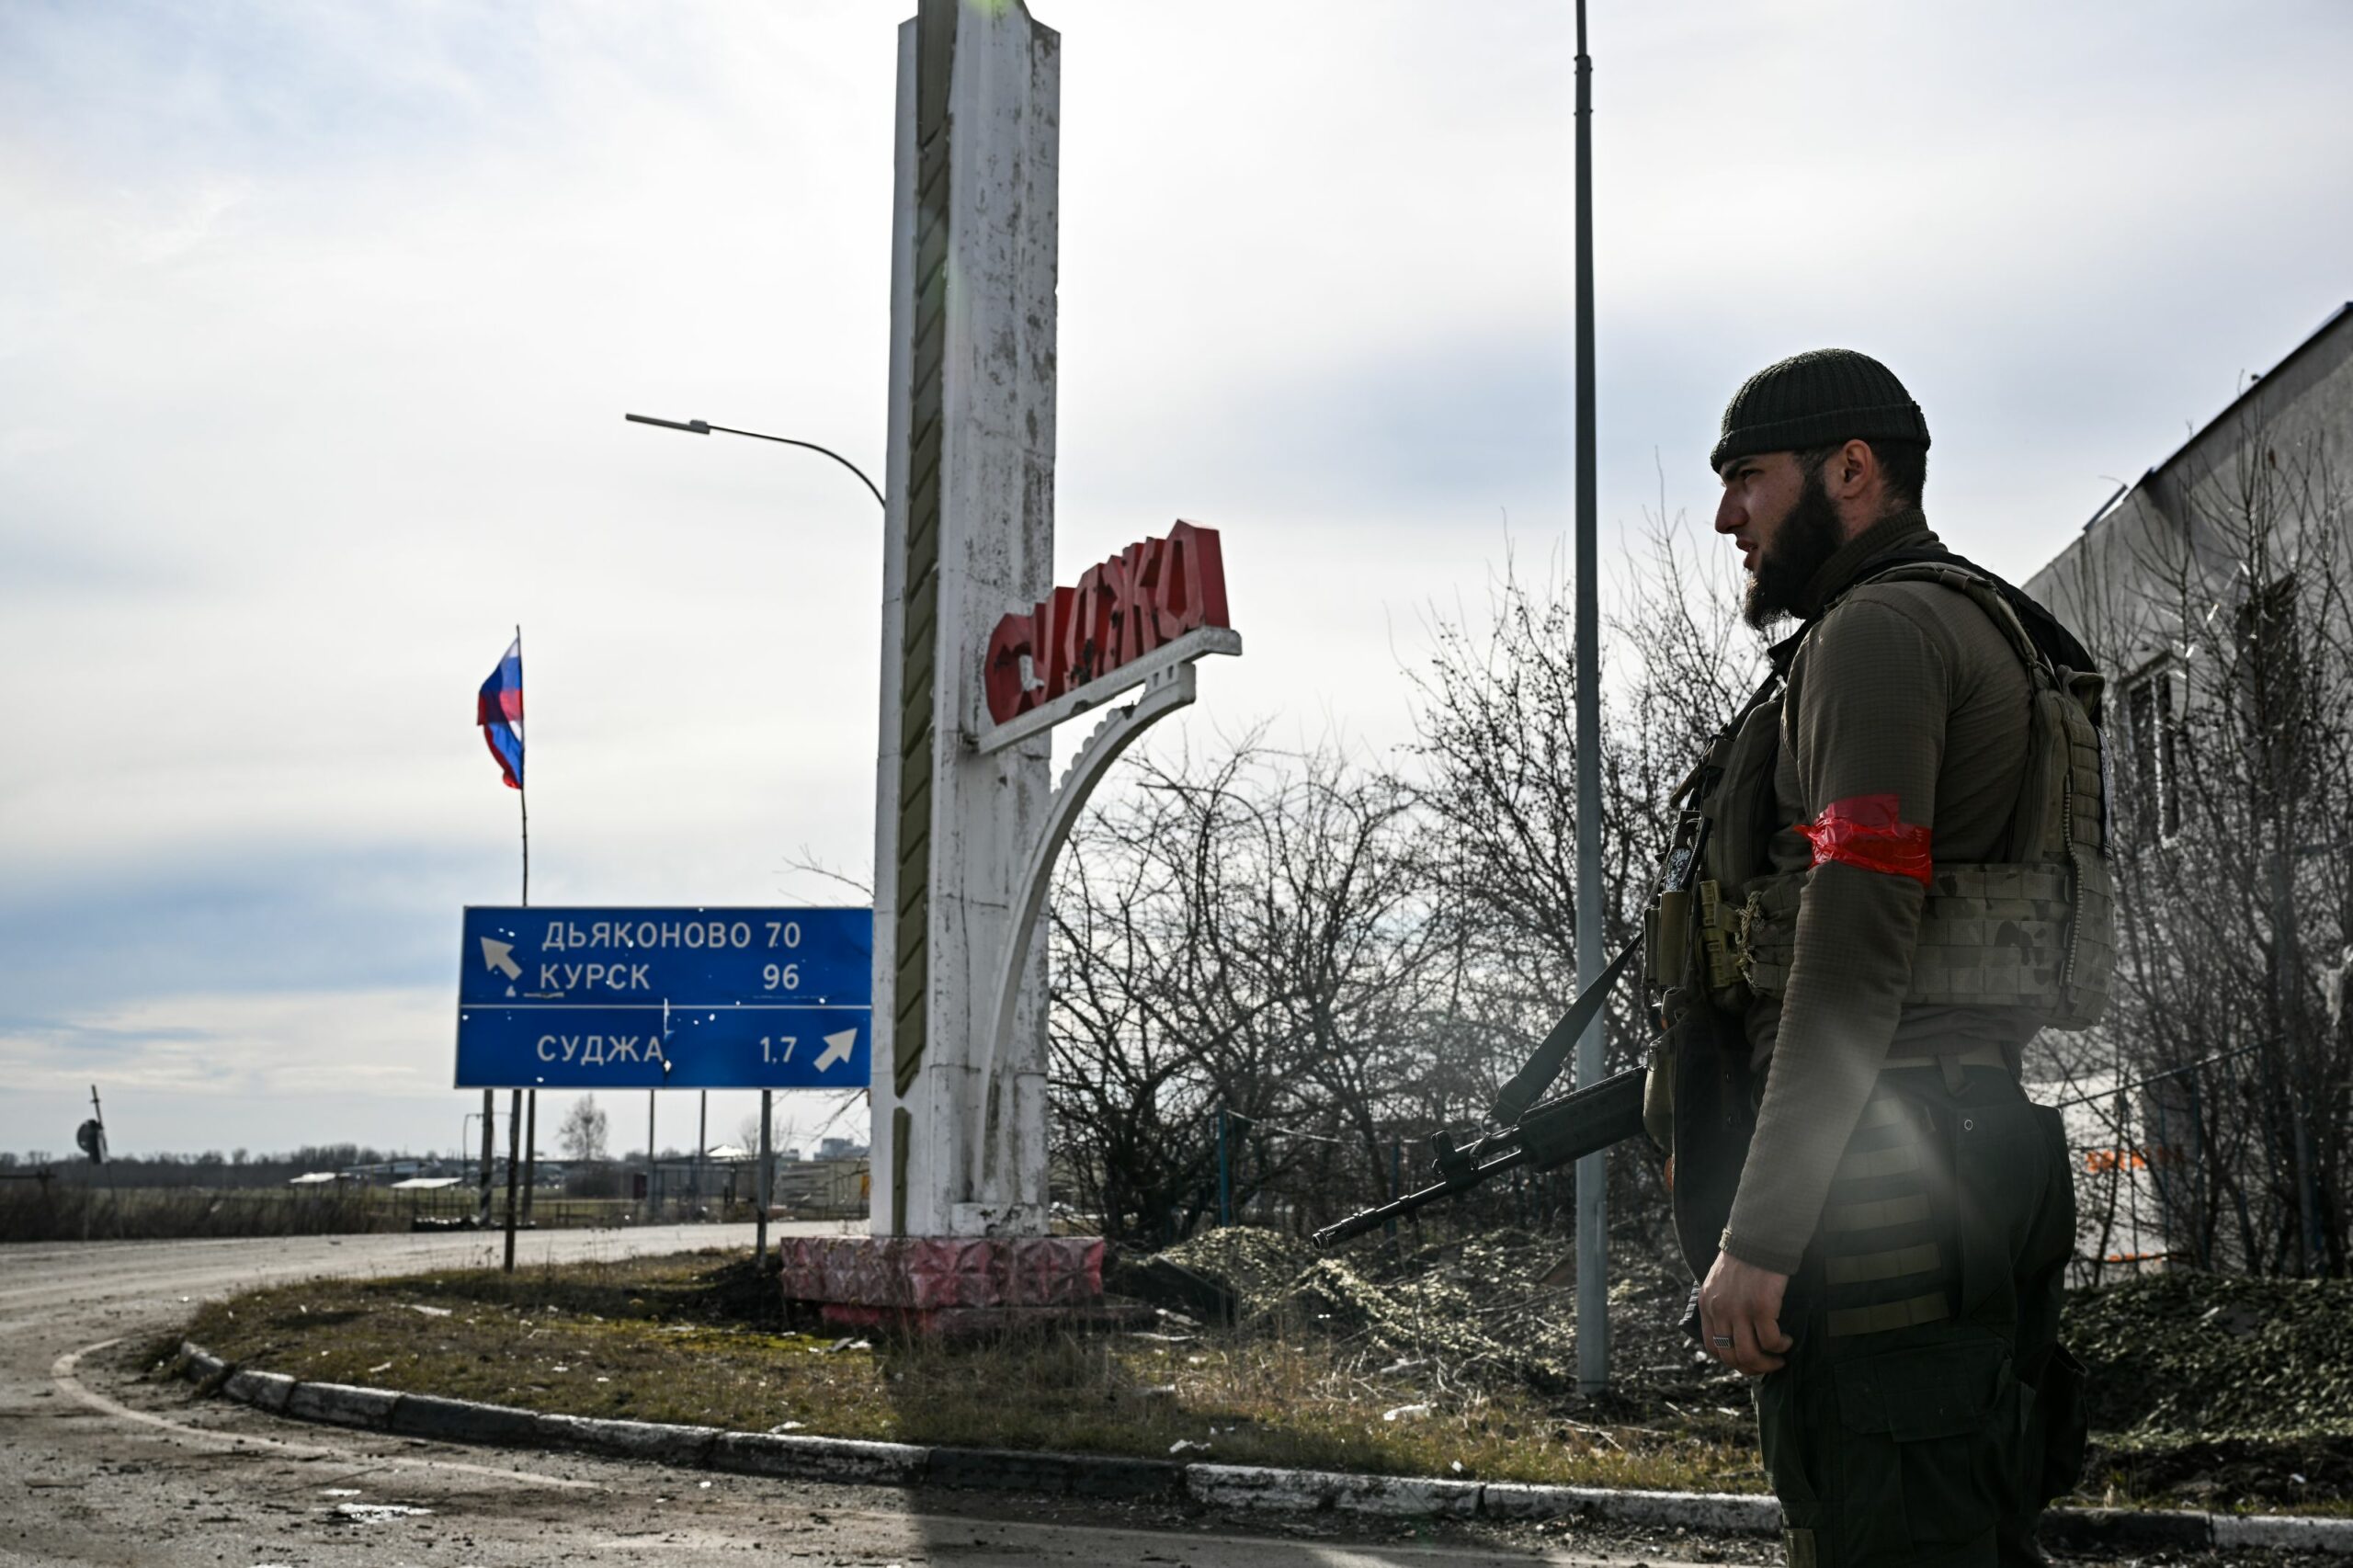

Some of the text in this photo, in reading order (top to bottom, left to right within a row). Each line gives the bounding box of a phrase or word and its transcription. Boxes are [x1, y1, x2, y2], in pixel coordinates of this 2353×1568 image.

[983, 518, 1230, 726] СУДЖА
[542, 922, 801, 950] ДЬЯКОНОВО 70
[540, 964, 800, 990] КУРСК 96
[537, 1035, 797, 1065] СУДЖА 1,7
